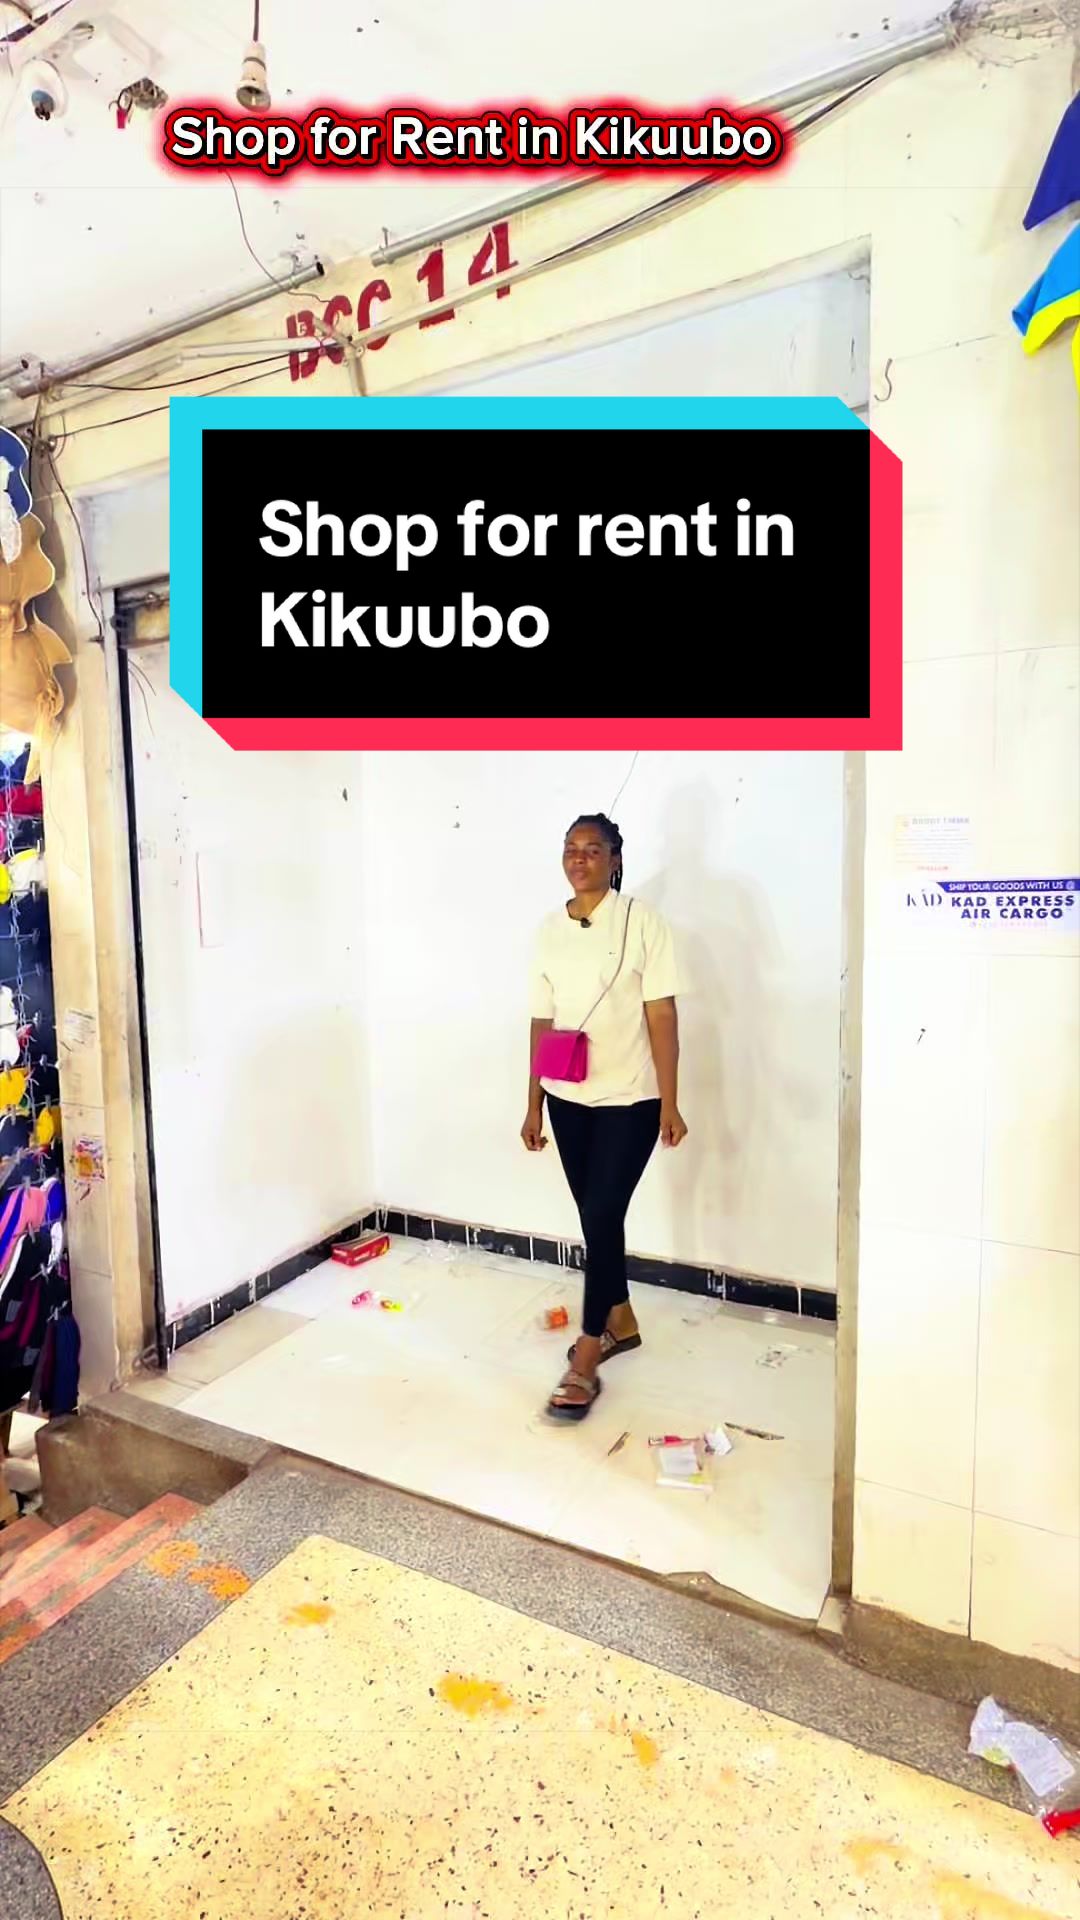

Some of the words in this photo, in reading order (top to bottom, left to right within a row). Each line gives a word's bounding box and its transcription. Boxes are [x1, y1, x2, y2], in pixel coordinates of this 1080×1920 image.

[949, 883, 966, 891] SHIP
[968, 883, 990, 891] YOUR
[992, 882, 1024, 890] GOODS
[1025, 881, 1050, 889] WITH
[1052, 881, 1063, 889] US
[951, 896, 987, 907] KAD
[996, 895, 1075, 906] EXPRESS
[961, 908, 991, 919] AIR
[1000, 907, 1063, 919] CARGO
